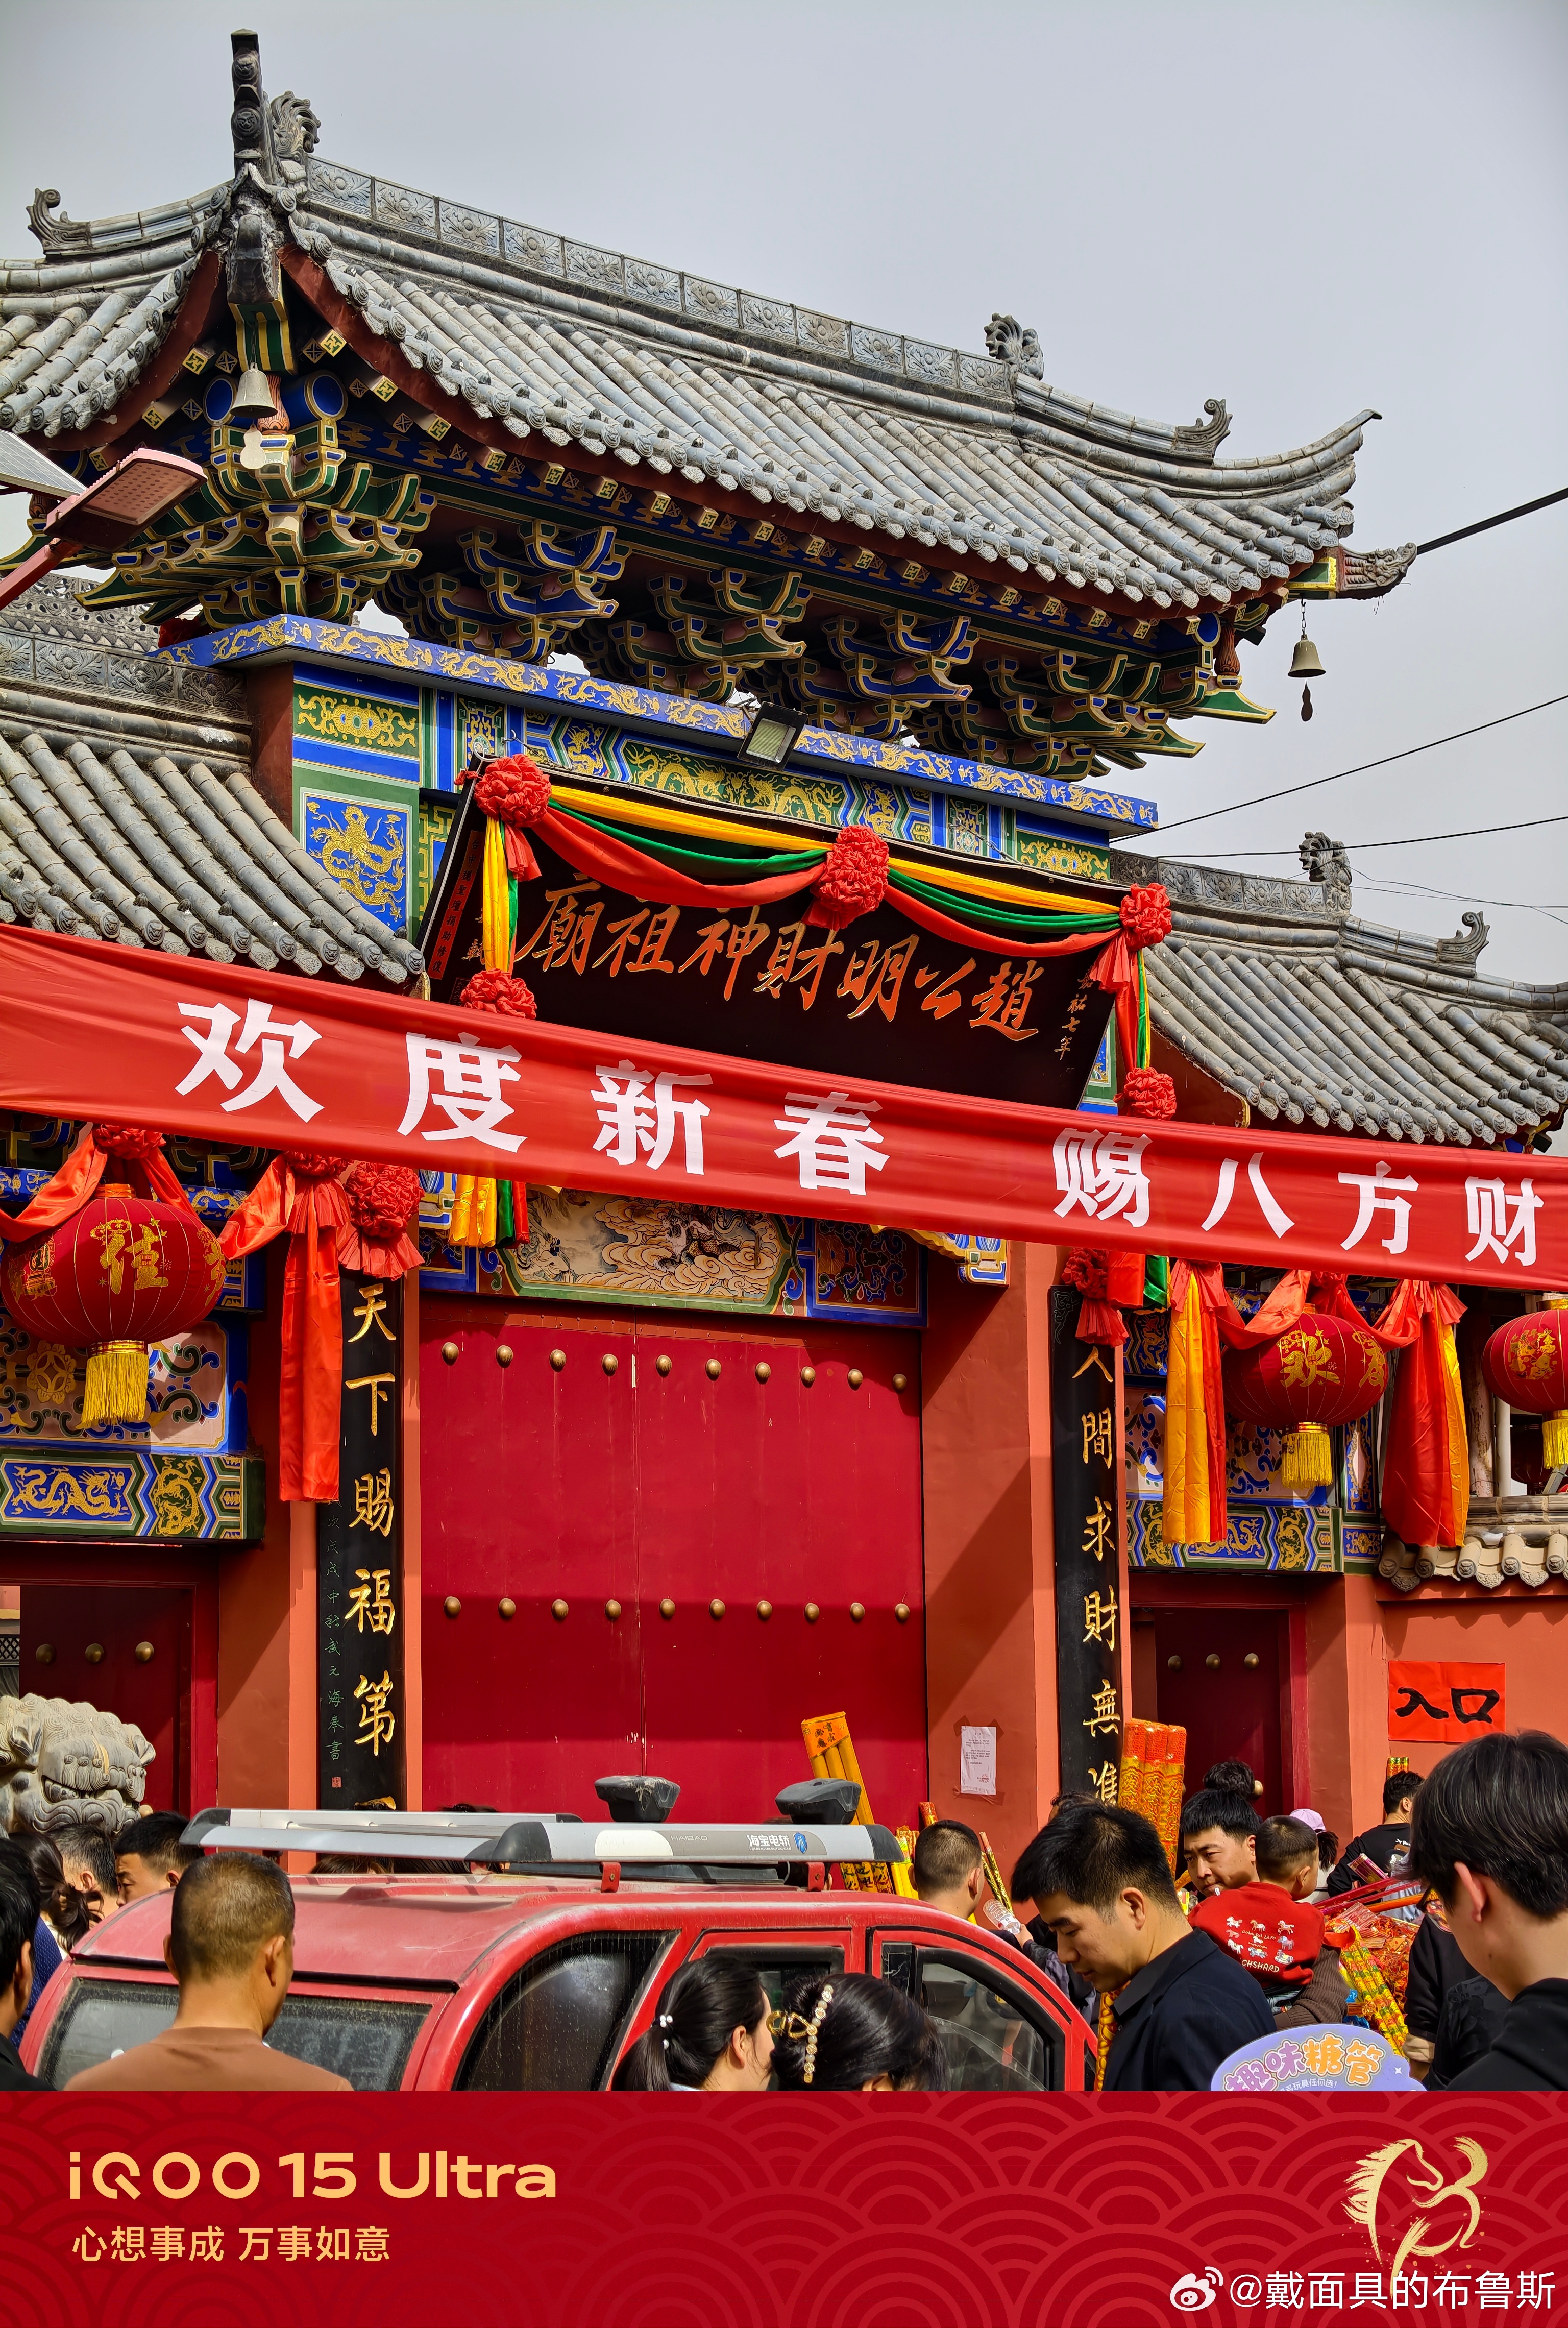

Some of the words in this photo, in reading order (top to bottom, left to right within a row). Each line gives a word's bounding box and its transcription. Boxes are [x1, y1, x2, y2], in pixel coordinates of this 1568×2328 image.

[175, 998, 890, 1197] 欢度新春
[1052, 1127, 1544, 1267] 赐八方财
[1395, 1688, 1499, 1724] 入口
[746, 1834, 790, 1847] 海宝电轿
[1239, 1957, 1280, 1973] CHSHARD
[1225, 2033, 1385, 2091] 趣味糖管
